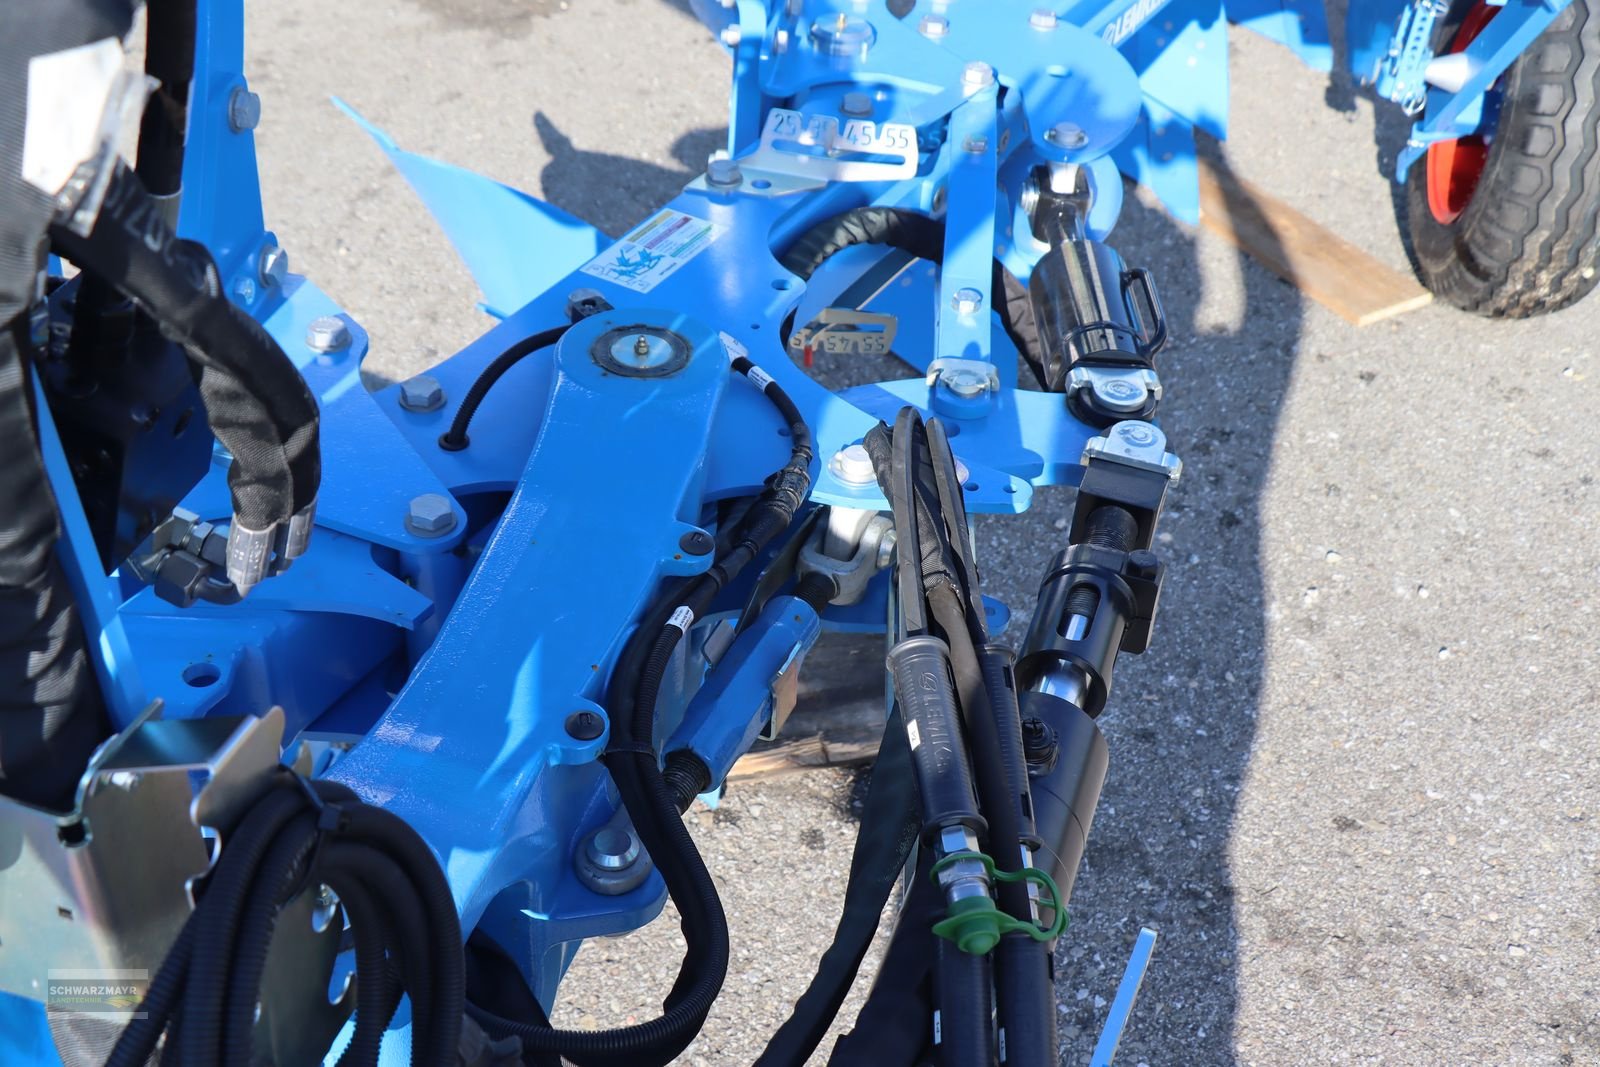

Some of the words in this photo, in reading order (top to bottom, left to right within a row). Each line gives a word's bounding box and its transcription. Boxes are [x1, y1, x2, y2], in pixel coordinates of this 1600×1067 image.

[773, 113, 797, 135] 25
[845, 124, 872, 146] 45
[885, 127, 909, 149] 55
